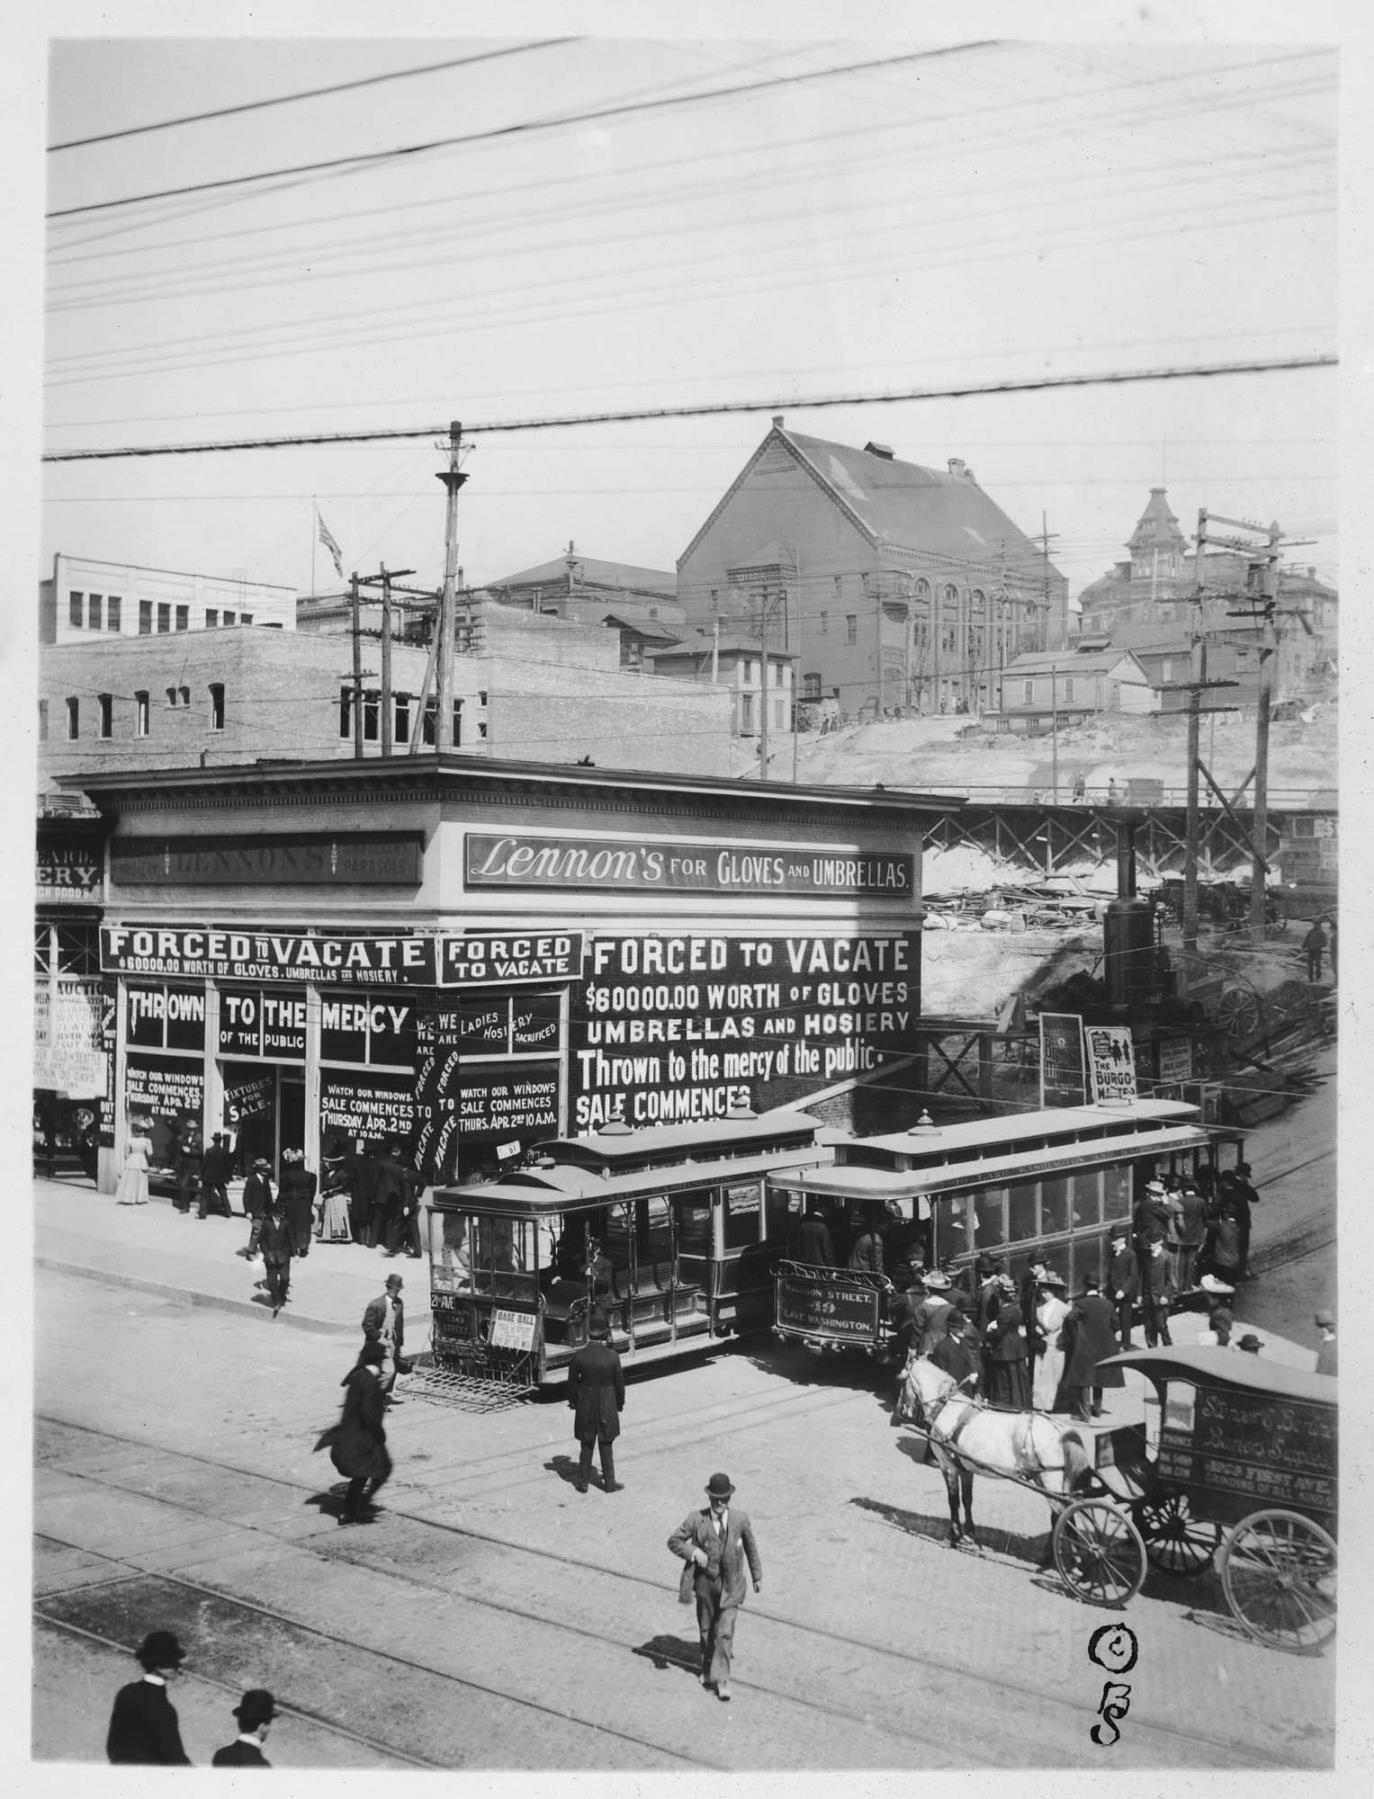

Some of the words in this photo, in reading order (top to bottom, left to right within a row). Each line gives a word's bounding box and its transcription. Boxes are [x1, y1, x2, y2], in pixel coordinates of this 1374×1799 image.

[471, 838, 664, 881] Lennon's
[671, 858, 706, 875] FOR
[717, 851, 784, 885] GLOVES
[788, 864, 809, 878] AND
[813, 859, 910, 888] UMBRELLAS.
[109, 930, 250, 960] FORCED
[256, 940, 268, 960] TO
[271, 938, 425, 967] VACATE
[448, 938, 571, 961] FORCED
[594, 939, 727, 975] FORCED
[740, 942, 772, 966] TO
[786, 939, 909, 974] VACATE
[183, 960, 214, 974] WORTH
[217, 962, 229, 975] OF
[286, 967, 337, 981] UMBRELLAS
[455, 962, 486, 978] TO
[494, 958, 569, 977] VACATE
[586, 982, 699, 1012] $60000.00
[708, 984, 779, 1009] WORTH
[790, 986, 812, 1001] OF
[817, 982, 908, 1006] GLOVES
[129, 991, 204, 1036] THROWN
[225, 997, 255, 1025] TO
[264, 999, 306, 1029] THE
[322, 1001, 409, 1034] MERCY
[438, 1014, 457, 1029] WE
[461, 1012, 498, 1035] LADIES
[483, 1012, 532, 1039] HOSIERY
[515, 1023, 556, 1043] SACRIFICED
[587, 1016, 755, 1044] UMBRELLAS
[763, 1018, 796, 1034] AND
[804, 1012, 909, 1035] HOSIERY
[220, 1031, 232, 1043] OF
[238, 1033, 259, 1046] THE
[265, 1034, 304, 1049] PUBLIC
[438, 1035, 457, 1044] ARE
[416, 1046, 434, 1056] ARE
[437, 1050, 459, 1094] FORCED
[577, 1049, 660, 1090] Thrown
[669, 1050, 685, 1080] to
[691, 1048, 719, 1081] the
[724, 1050, 774, 1081] mercy
[776, 1044, 790, 1072] of
[795, 1040, 819, 1072] the
[127, 1080, 144, 1092] SALE
[149, 1071, 163, 1082] OUR
[414, 1057, 435, 1100] FORCED
[224, 1077, 272, 1102] FIXTURES
[242, 1091, 261, 1103] FOR
[328, 1084, 353, 1096] WATCH
[357, 1088, 373, 1098] OUR
[460, 1087, 487, 1098] WATCH
[491, 1086, 508, 1096] OUR
[513, 1082, 556, 1095] WINDOWS
[151, 1106, 160, 1114] AT
[322, 1097, 347, 1111] SALE
[350, 1100, 414, 1118] COMMENCES
[417, 1105, 431, 1118] TO
[438, 1098, 454, 1111] TO
[461, 1101, 484, 1114] SALE
[490, 1096, 551, 1112] COMMENCES
[577, 1093, 627, 1125] SALE
[634, 1085, 750, 1120] COMMENCES
[458, 1117, 489, 1132] THURS.
[525, 1113, 534, 1126] 10
[348, 1129, 357, 1137] AT
[435, 1115, 457, 1170] VACATE
[414, 1121, 434, 1171] VACATE
[828, 1290, 872, 1303] STREET.
[497, 1311, 515, 1323] BASE
[517, 1314, 534, 1326] BALL
